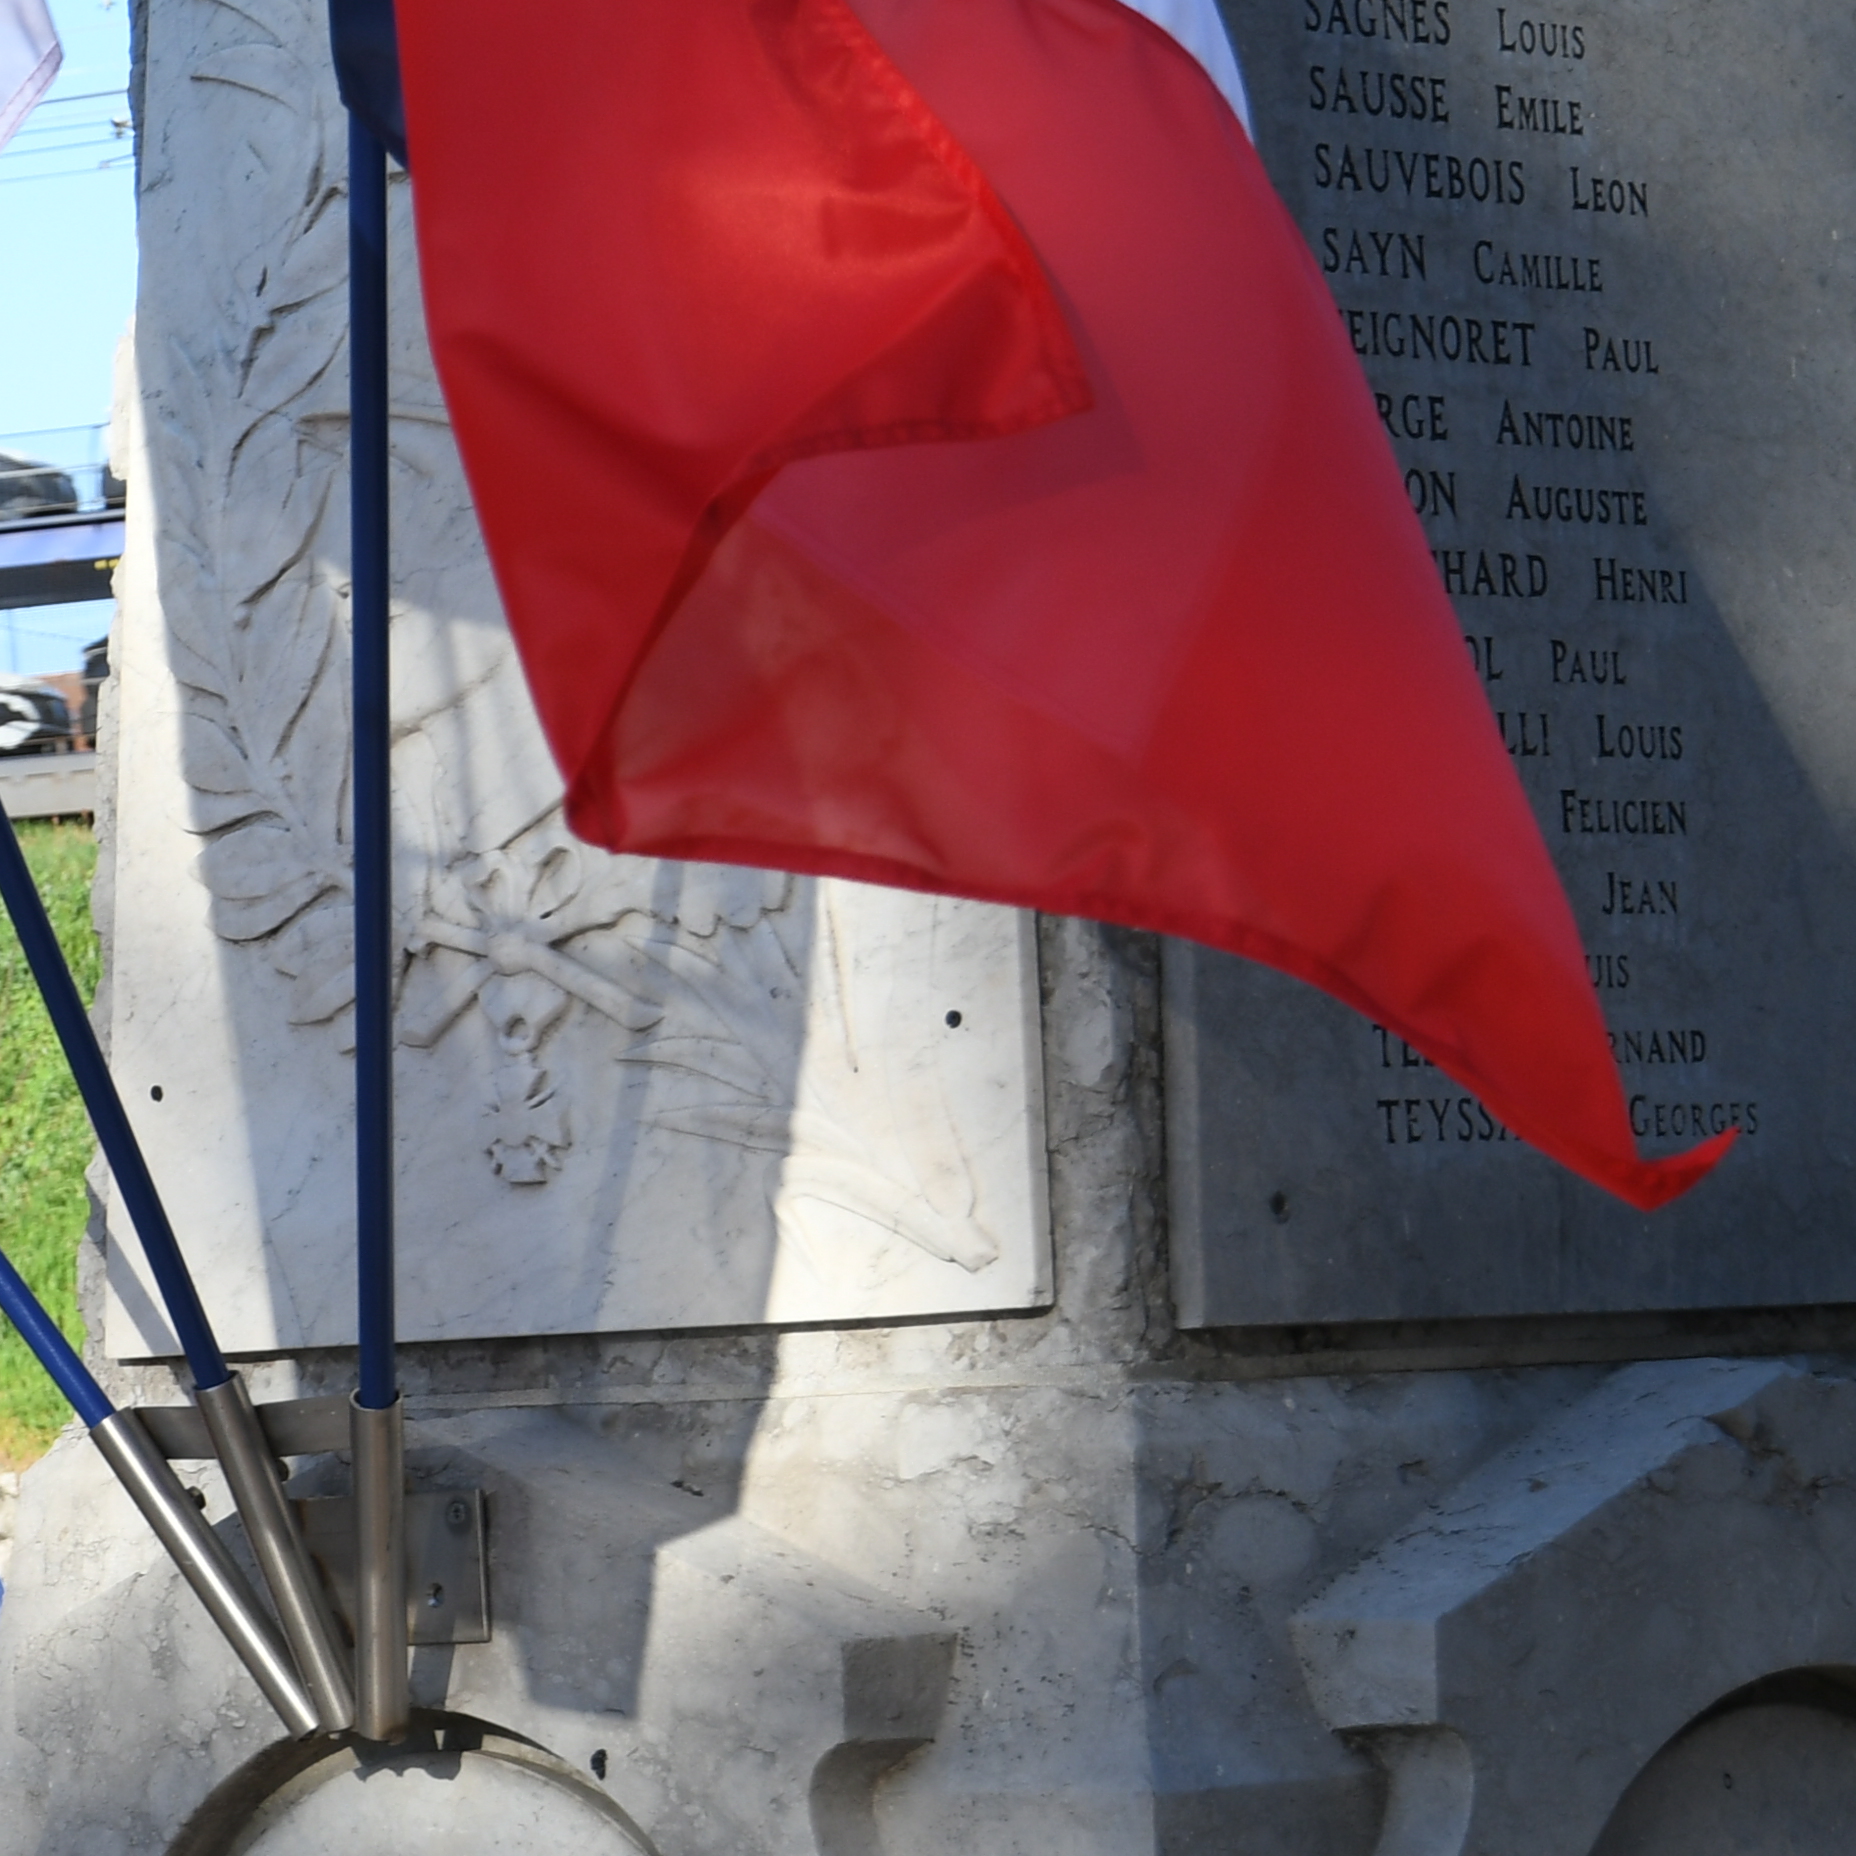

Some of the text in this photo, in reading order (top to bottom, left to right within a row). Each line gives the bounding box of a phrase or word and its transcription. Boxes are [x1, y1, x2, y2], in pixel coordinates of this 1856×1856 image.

[1305, 0, 1585, 60] SAGNES LOUIS
[1310, 66, 1583, 135] SAUSSE EMILE
[1315, 143, 1648, 217] SAUVEBOIS LEON
[1323, 228, 1602, 292] SAYN CAMILLE
[1338, 309, 1658, 374] EIGNORET PAUL
[1496, 399, 1634, 451] ANTOINE
[1506, 474, 1647, 525] AUGUSTE
[1593, 558, 1687, 604] HENRI
[1550, 640, 1626, 685] PAUL
[1596, 714, 1682, 760] LOUIS
[1560, 789, 1686, 835] FELICIEN
[1602, 872, 1677, 915] JEAN
[1377, 1094, 1757, 1144] TEYSS GEORGES
